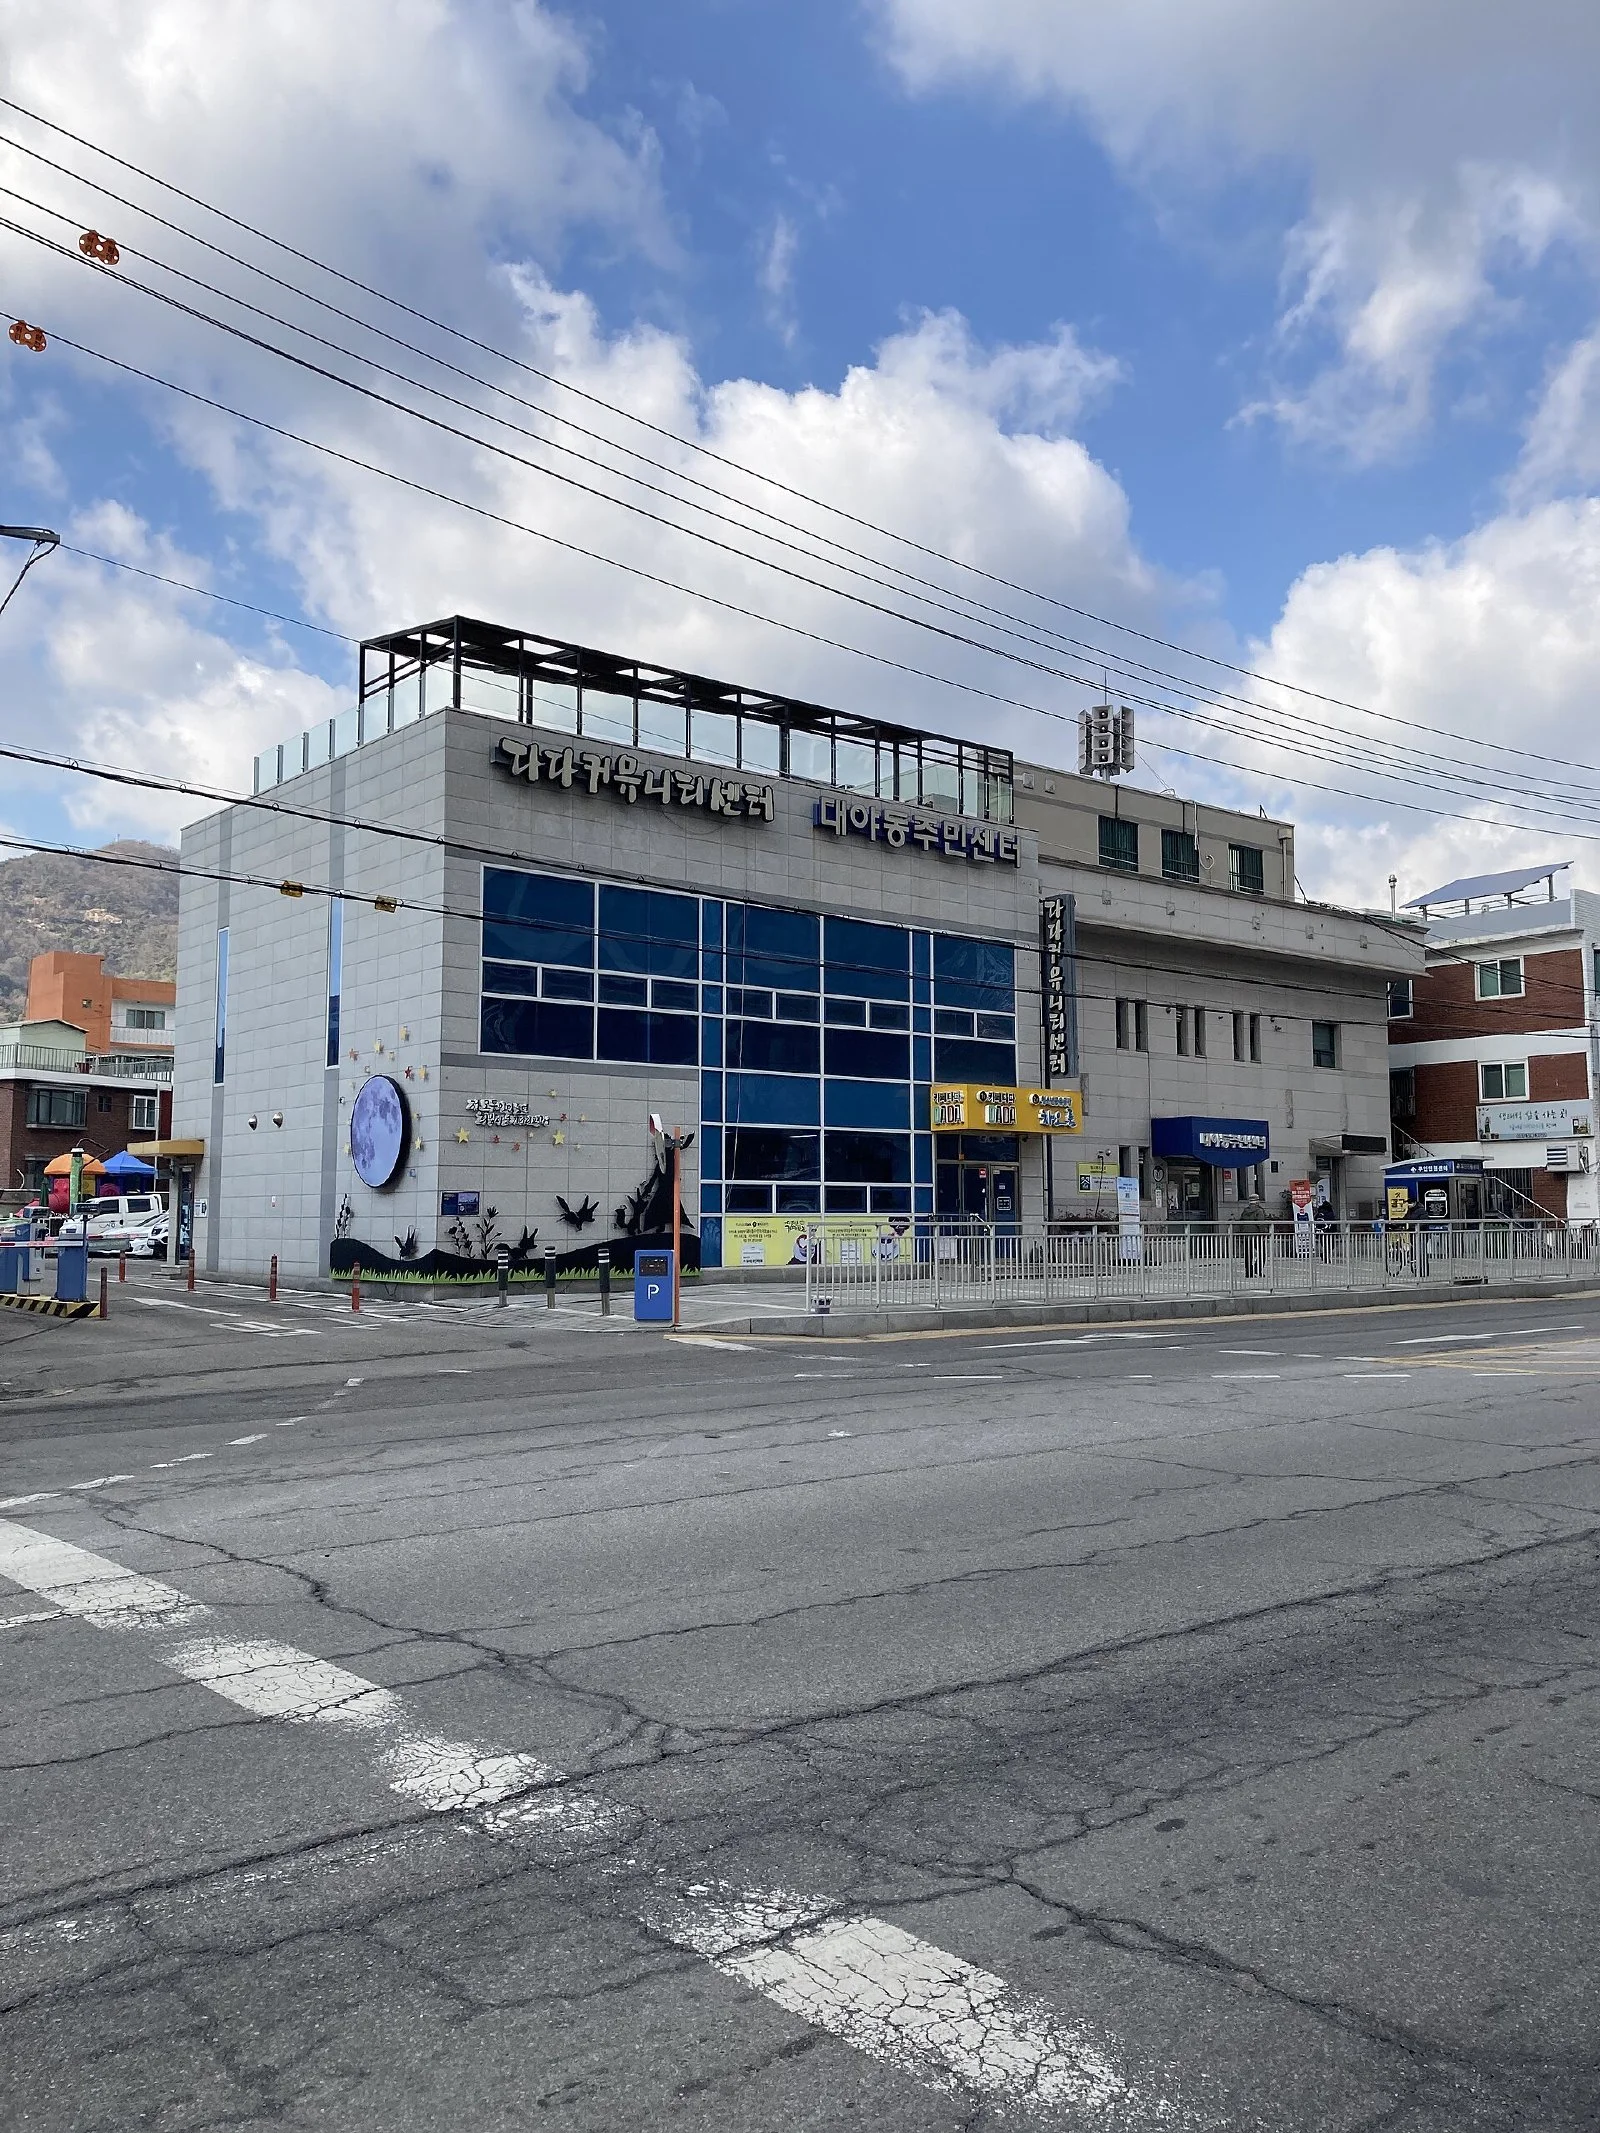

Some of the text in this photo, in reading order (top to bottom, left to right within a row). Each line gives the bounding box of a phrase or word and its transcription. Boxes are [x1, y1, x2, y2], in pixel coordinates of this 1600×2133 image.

[500, 736, 775, 823] 다다커뮤니티센터
[820, 796, 1021, 868] 대야동주민센터
[1044, 898, 1066, 1074] 다다커뮤니티센터
[647, 1284, 659, 1300] P
